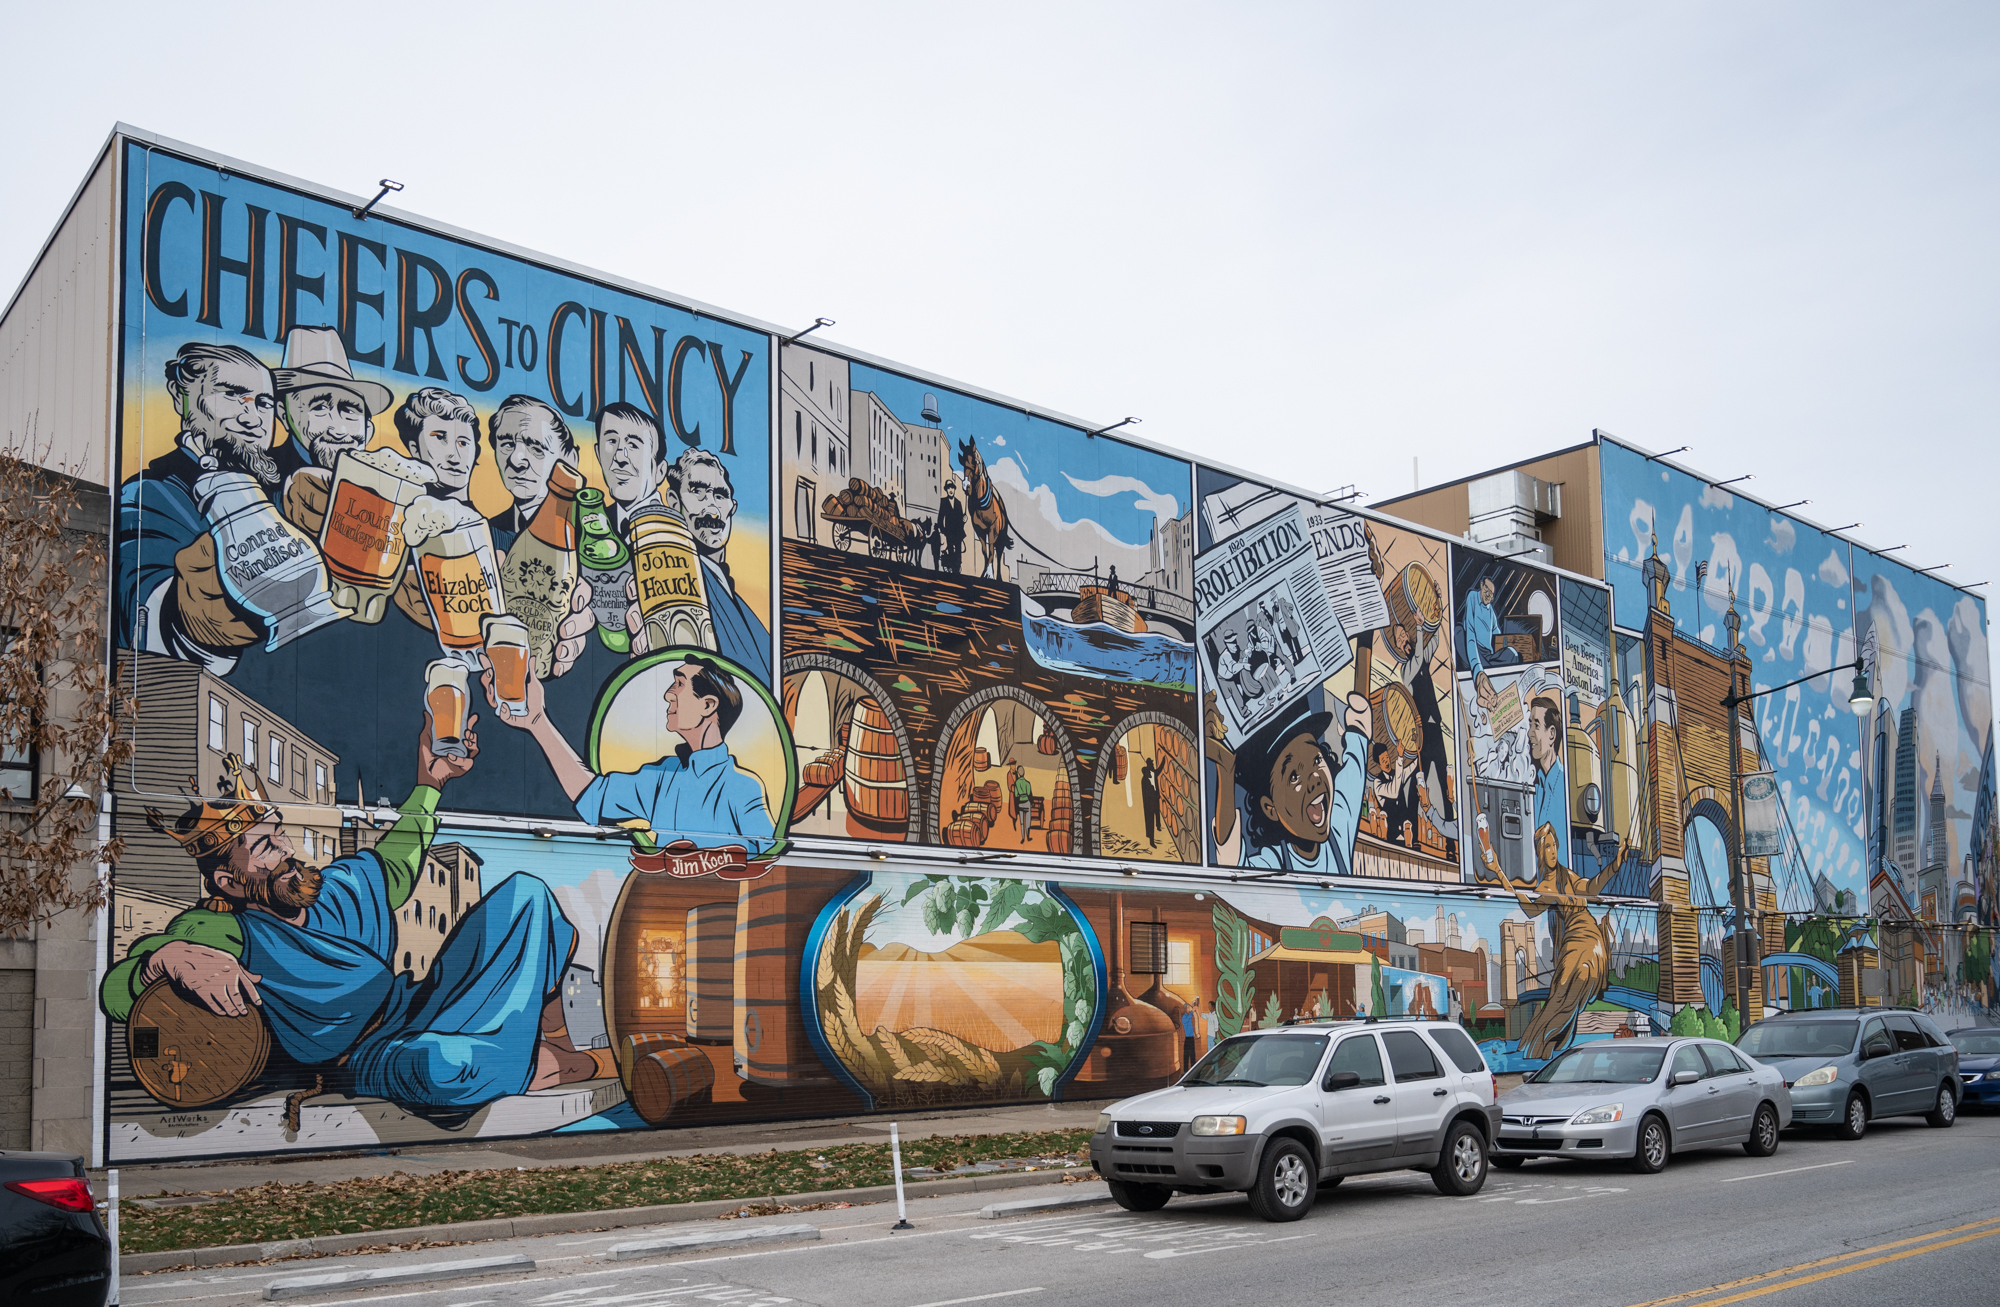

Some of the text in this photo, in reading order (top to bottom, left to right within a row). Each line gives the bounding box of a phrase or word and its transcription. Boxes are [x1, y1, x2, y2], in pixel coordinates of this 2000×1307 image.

[143, 180, 754, 456] CHEERS TO CINCY
[344, 497, 400, 536] Louis
[1306, 515, 1323, 528] 1933
[225, 521, 291, 563] Conrad
[331, 512, 402, 556] Hudepohl
[1228, 538, 1246, 555] 1920
[1310, 520, 1366, 561] ENDS
[225, 537, 311, 588] Windisch
[641, 551, 690, 572] John
[1194, 519, 1303, 618] PROHIBITION
[424, 565, 493, 596] Elizabeth
[593, 585, 627, 598] Edward
[641, 575, 701, 601] Hauck
[440, 593, 494, 614] Koch
[524, 605, 540, 617] OLD
[525, 616, 553, 632] LAGER
[1564, 634, 1603, 667] Best Beer in
[1565, 667, 1590, 693] Boston
[1571, 654, 1600, 681] America
[672, 849, 734, 875] Jim Koch
